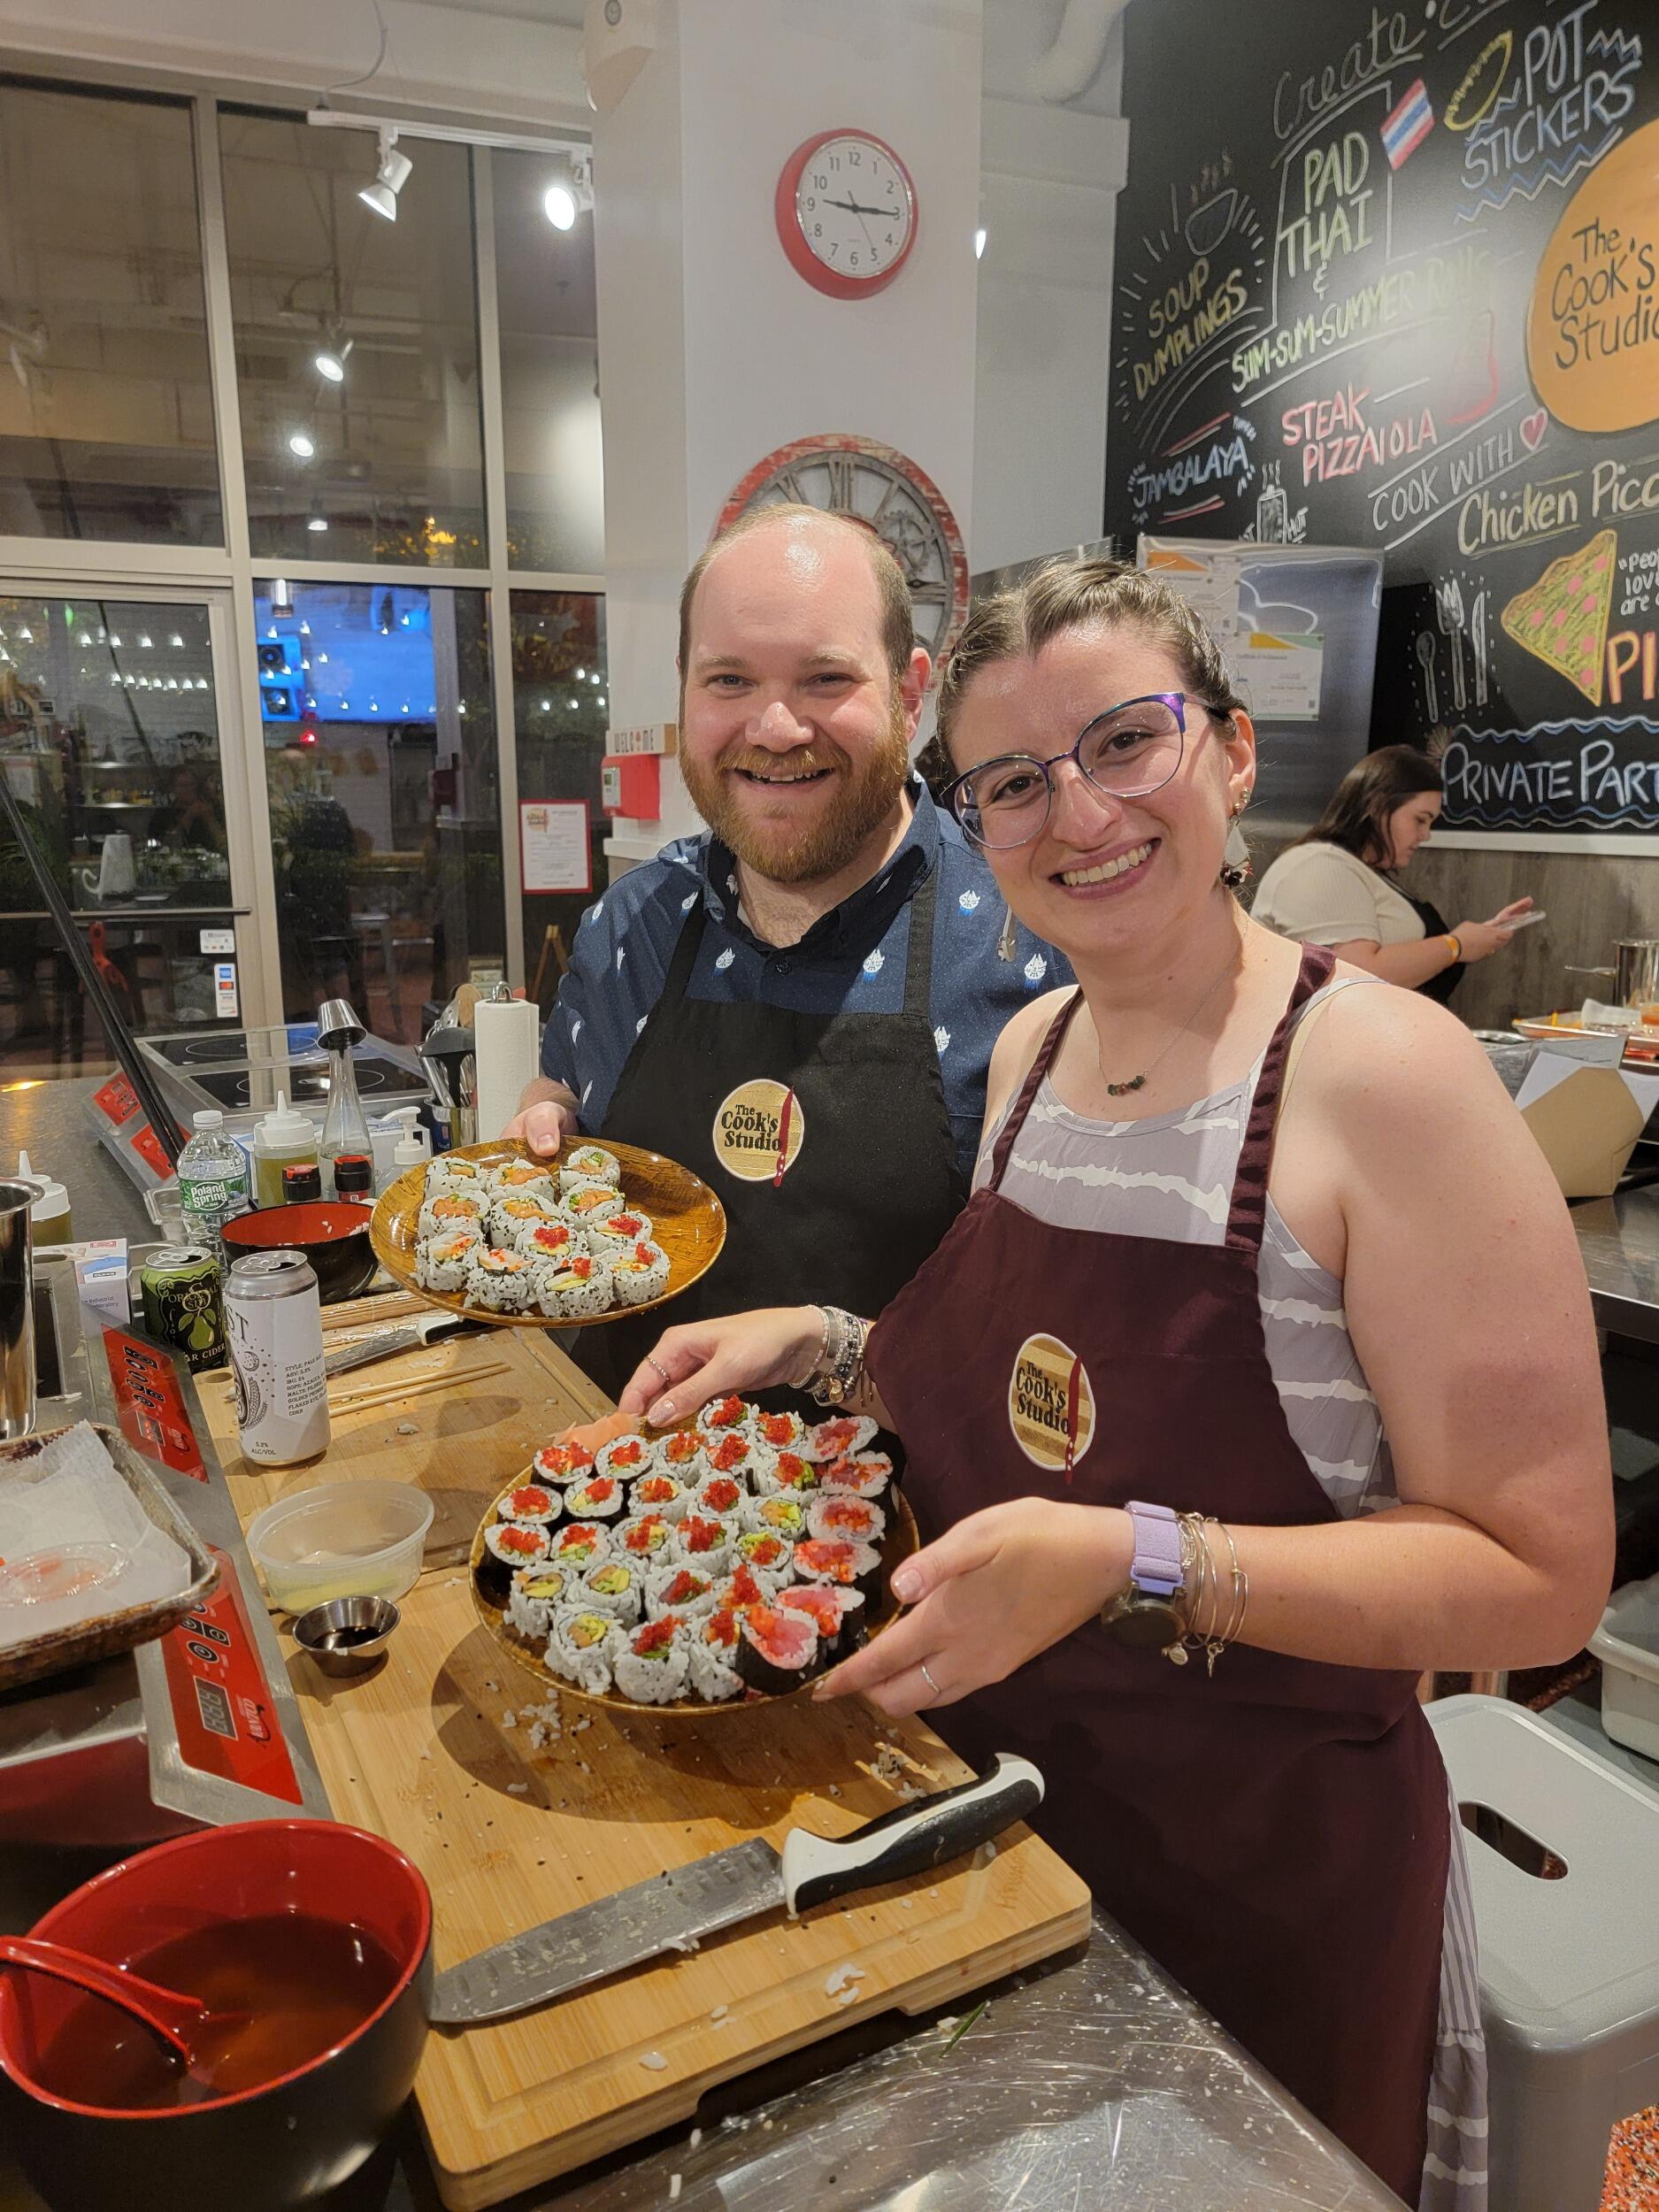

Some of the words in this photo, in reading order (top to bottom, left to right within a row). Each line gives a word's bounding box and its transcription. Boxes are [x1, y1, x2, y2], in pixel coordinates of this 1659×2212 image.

[1524, 2, 1598, 106] POT
[1273, 7, 1427, 139] Create
[1461, 59, 1642, 189] STICKERS
[830, 156, 841, 172] 11
[848, 151, 862, 166] 12
[872, 161, 878, 175] 1
[813, 175, 827, 190] 10
[1304, 132, 1370, 214] PAD
[886, 180, 895, 195] 2
[806, 196, 816, 211] 9
[893, 206, 901, 221] 3
[813, 223, 823, 237] 8
[885, 233, 893, 247] 4
[1279, 189, 1373, 278] THAI
[1571, 217, 1622, 265] The
[830, 242, 839, 257] 7
[849, 251, 858, 265] 6
[871, 247, 879, 262] 5
[1312, 261, 1331, 301] &
[1148, 257, 1210, 339] SOUP
[1133, 268, 1248, 402] DUMPLINGS
[1281, 381, 1371, 447] STEAK
[1302, 407, 1438, 488] PIZZAIOLA
[1133, 435, 1249, 510] JAMBALAYA
[1372, 465, 1440, 531] COOK
[1449, 425, 1515, 495] WITH
[1457, 482, 1579, 557] Chicken
[1620, 594, 1650, 617] are
[615, 728, 654, 753] WELCME
[1440, 741, 1574, 809] PRIVATE
[721, 1110, 779, 1133] Cook's
[735, 1104, 756, 1116] The
[724, 1130, 781, 1151] Studio
[190, 1181, 227, 1198] Poland
[192, 1191, 228, 1209] Spring
[202, 1343, 226, 1359] CIDER
[1026, 1361, 1042, 1379] The
[1016, 1367, 1066, 1410] Cook's
[1017, 1393, 1071, 1435] Studio
